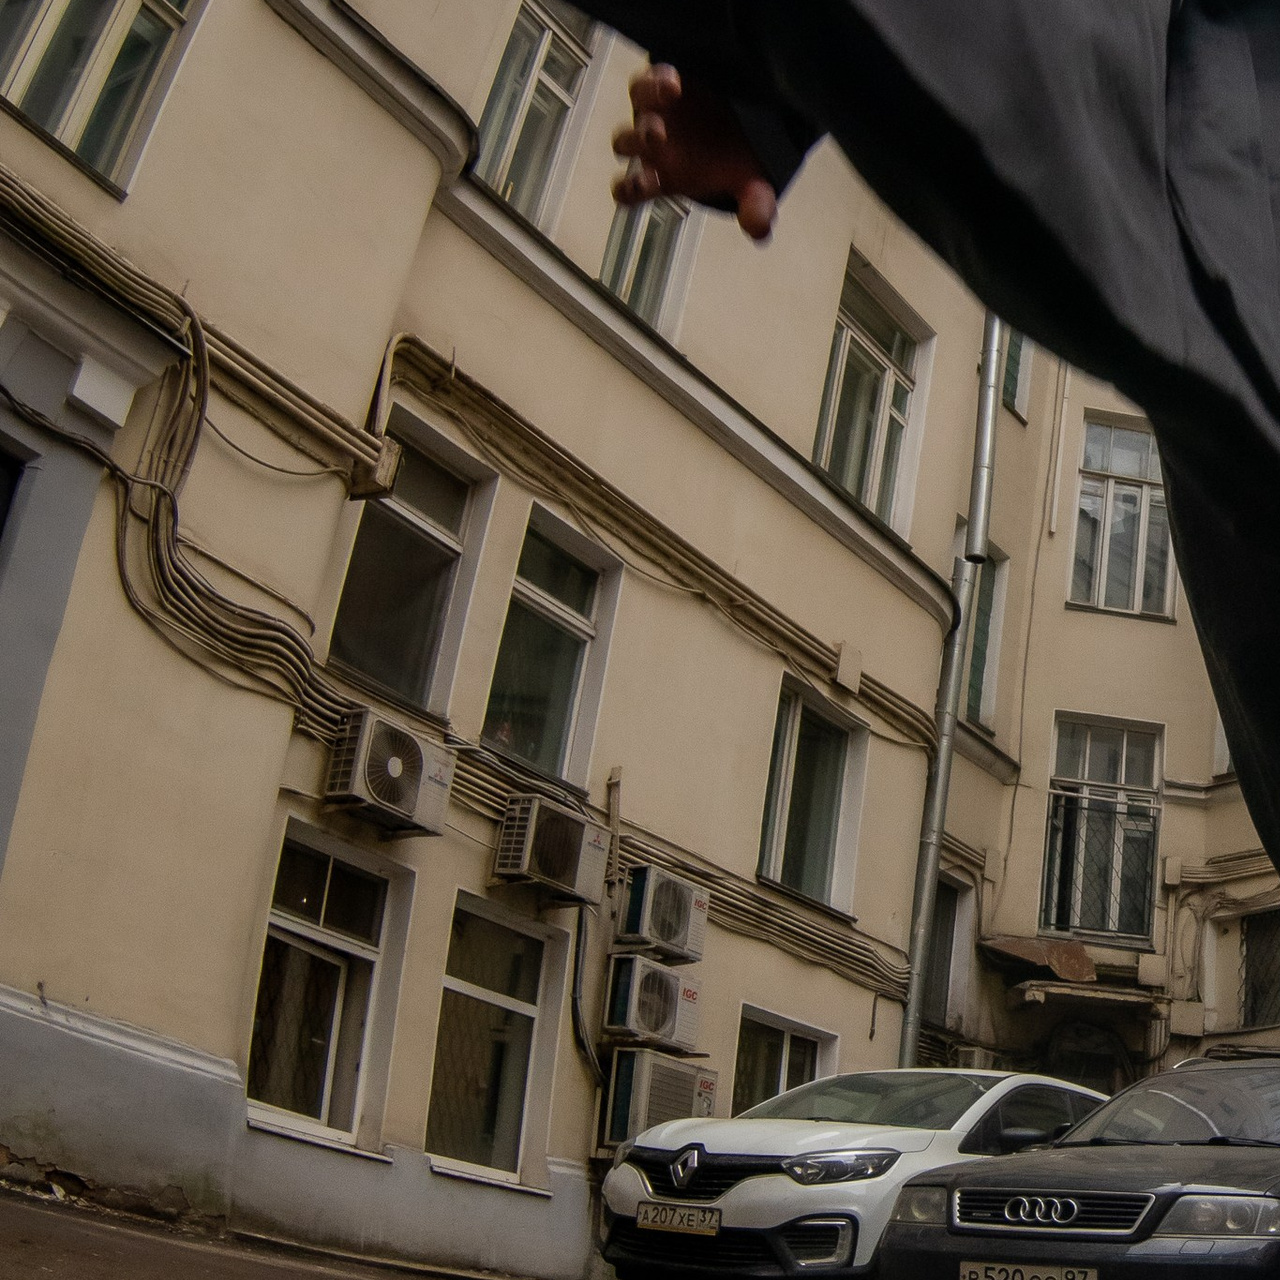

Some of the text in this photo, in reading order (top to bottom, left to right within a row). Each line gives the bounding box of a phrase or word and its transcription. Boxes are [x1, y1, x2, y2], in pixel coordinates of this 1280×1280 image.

[694, 898, 707, 910] IGC
[682, 987, 698, 1001] IGC
[699, 1079, 715, 1092] IGC
[700, 1209, 715, 1224] 37
